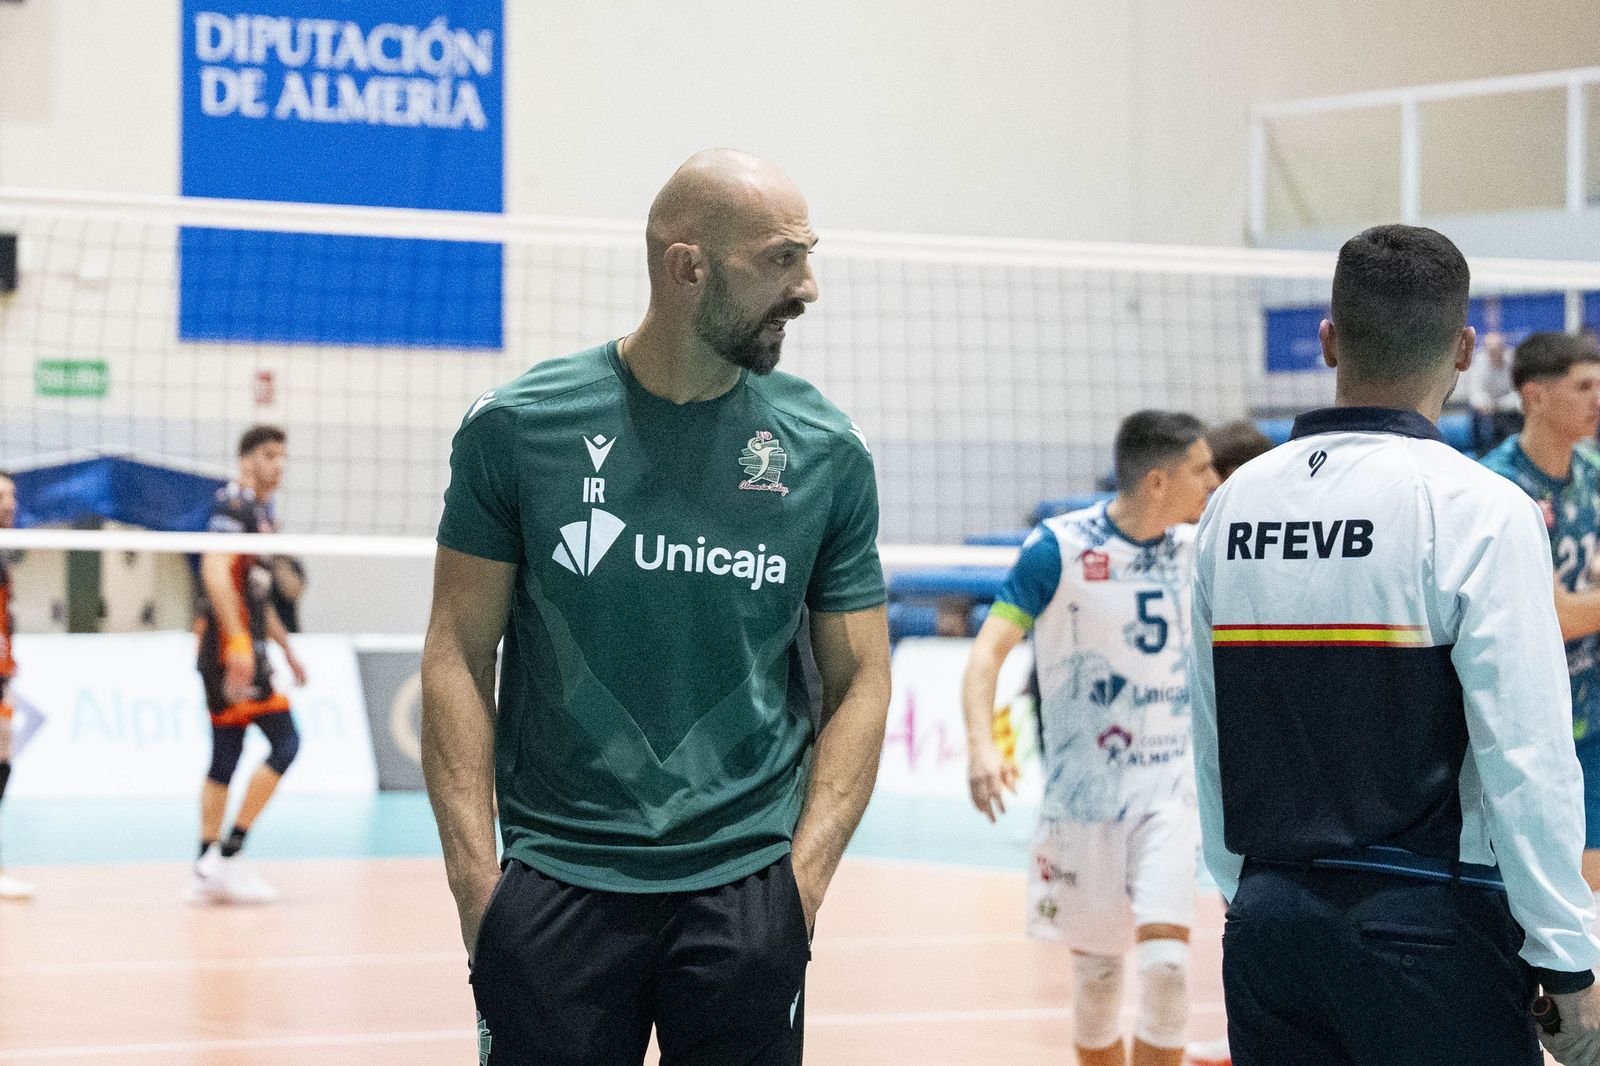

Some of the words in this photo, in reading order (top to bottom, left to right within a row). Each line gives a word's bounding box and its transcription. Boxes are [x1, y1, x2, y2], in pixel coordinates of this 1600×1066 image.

[195, 11, 494, 77] DIPUTACIÓN
[201, 65, 268, 118] DE
[274, 72, 488, 131] ALMERÍA
[582, 477, 606, 504] IR
[635, 533, 787, 591] Unicaja
[1227, 519, 1374, 560] RFEVB
[1135, 590, 1169, 654] 5
[1132, 684, 1190, 706] Unica
